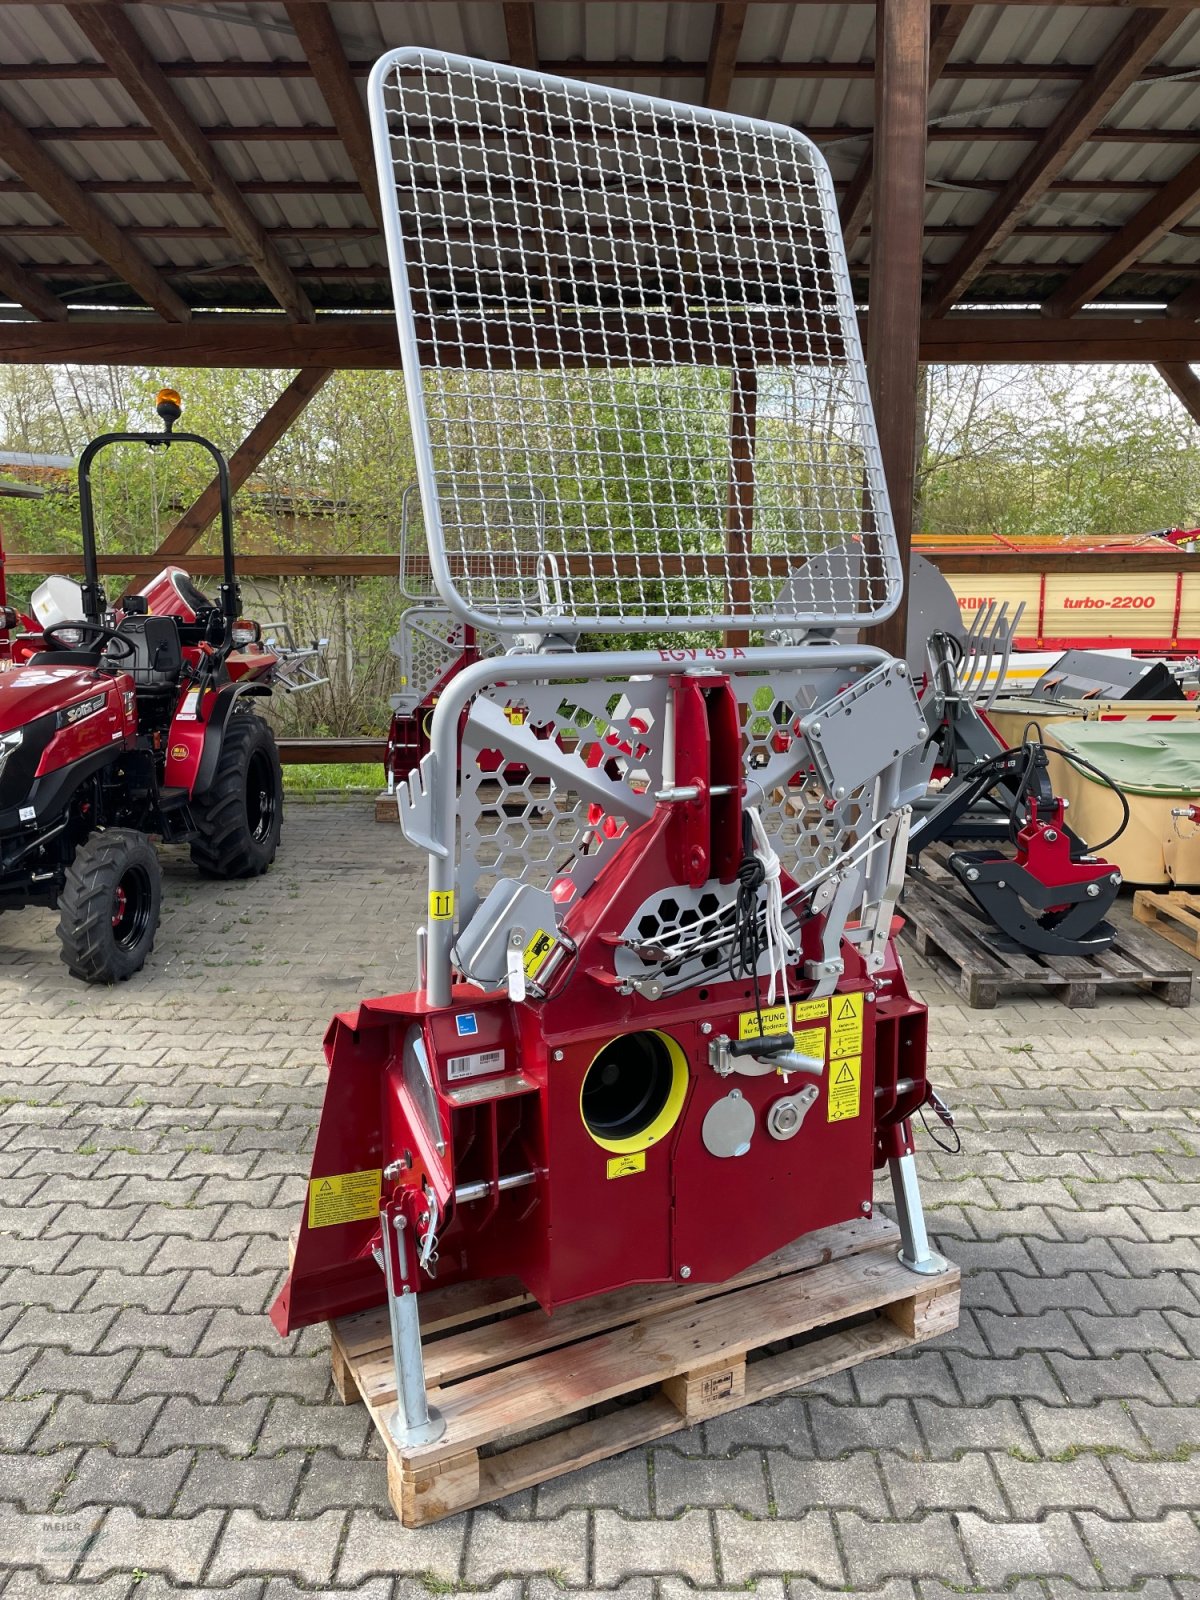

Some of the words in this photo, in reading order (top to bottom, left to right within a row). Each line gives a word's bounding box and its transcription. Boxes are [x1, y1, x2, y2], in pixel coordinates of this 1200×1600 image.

[1063, 596, 1155, 609] turbo-2200
[658, 647, 697, 662] EGV
[705, 647, 726, 660] 45
[732, 647, 746, 659] A
